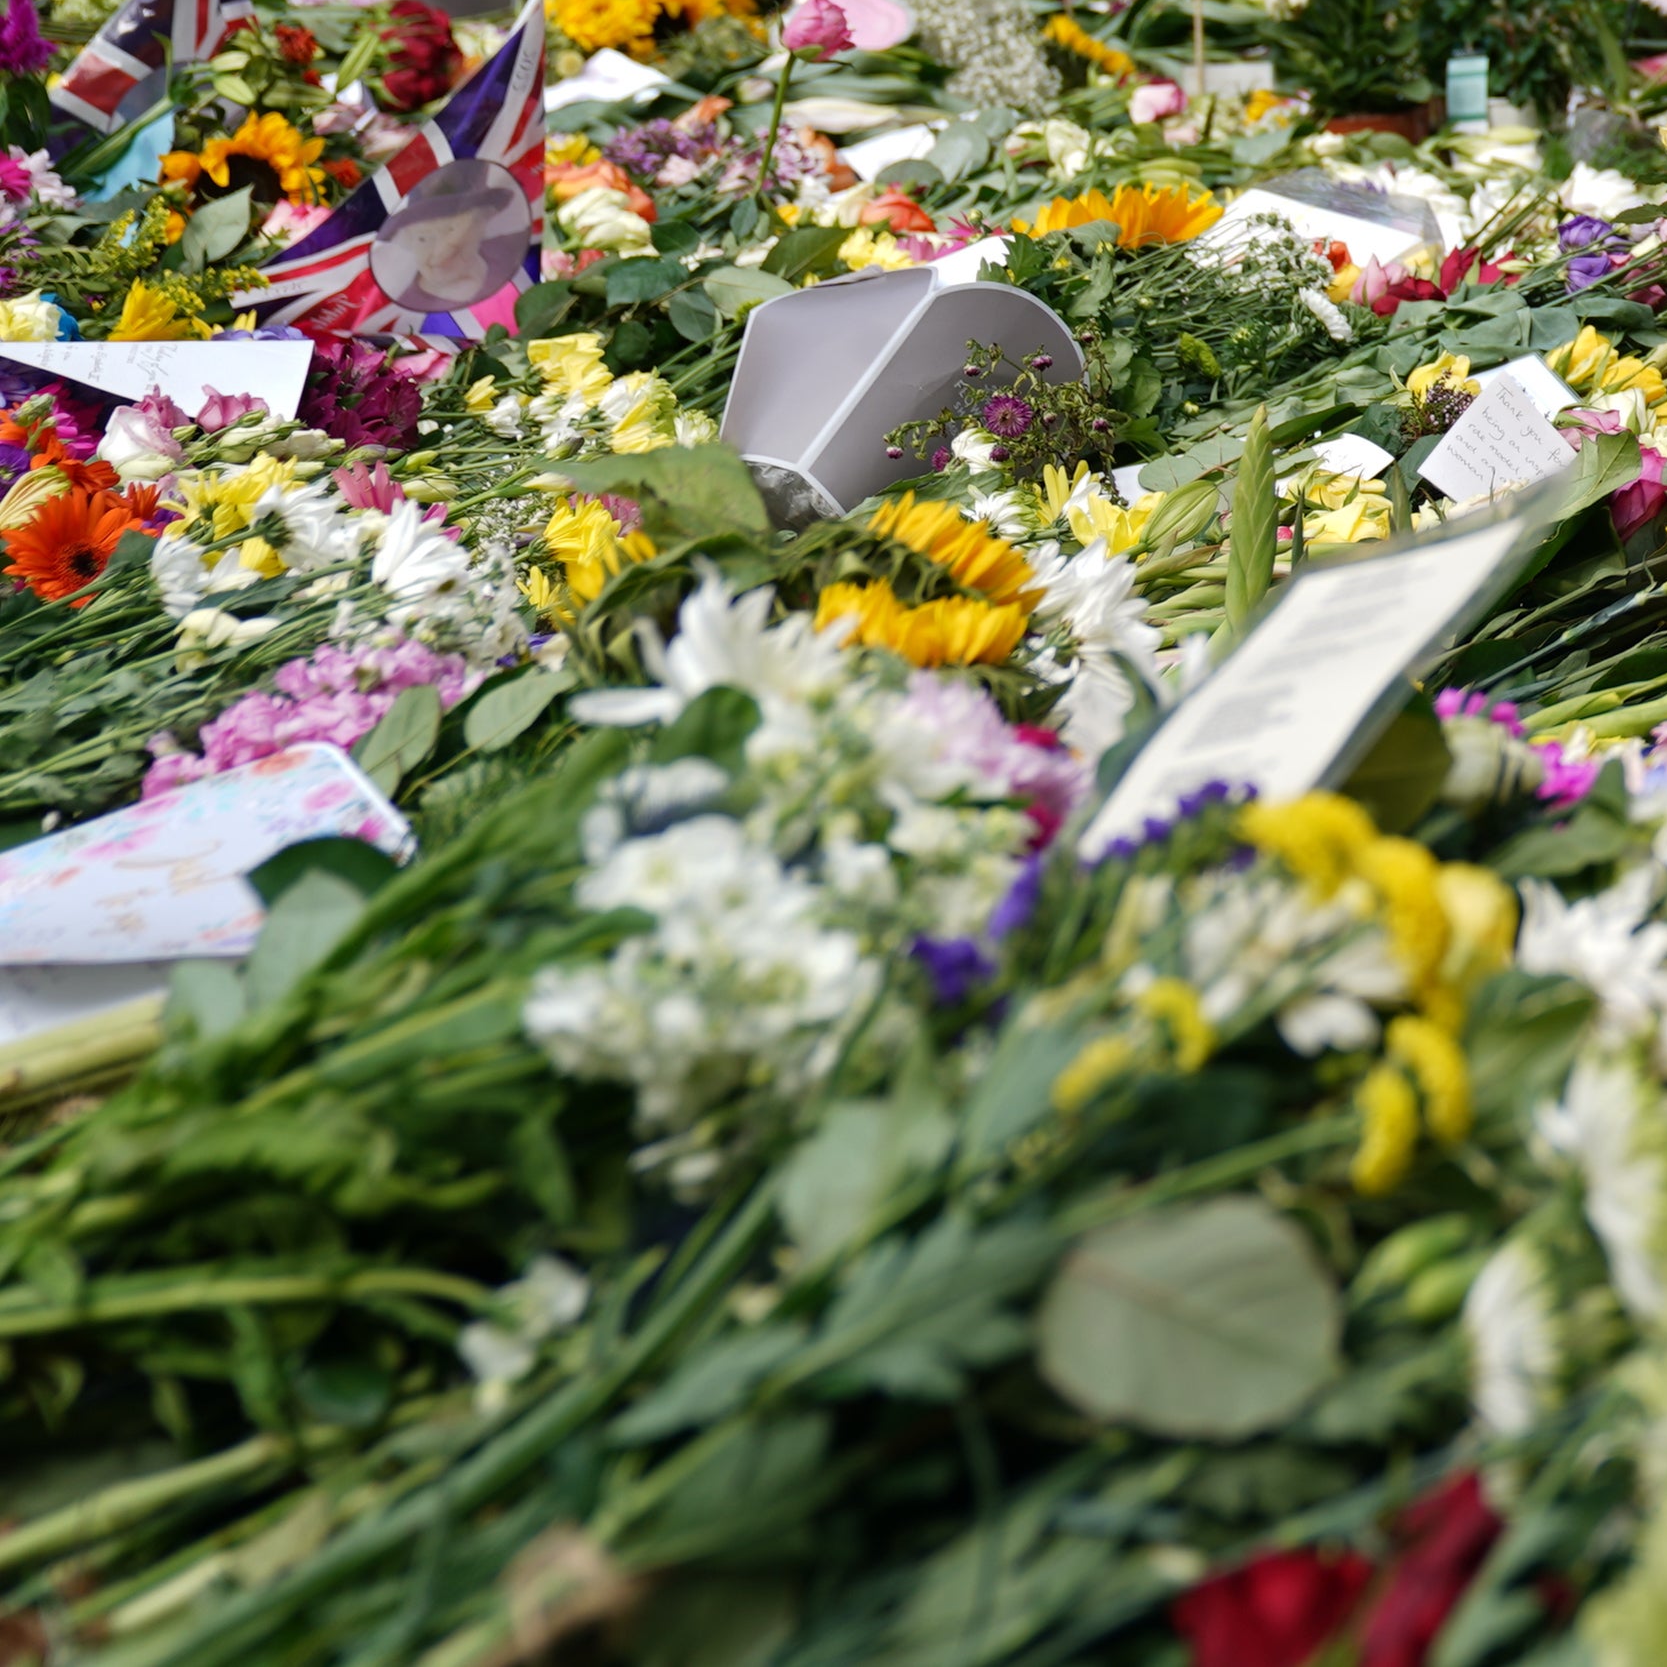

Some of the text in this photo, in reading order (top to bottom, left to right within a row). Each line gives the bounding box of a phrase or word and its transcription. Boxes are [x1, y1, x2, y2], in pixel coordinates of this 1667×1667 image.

[1467, 422, 1486, 443] role
[1482, 406, 1546, 478] being an insp
[1495, 382, 1523, 421] Thank
[1520, 425, 1543, 445] you
[1547, 447, 1567, 468] for
[1447, 443, 1485, 481] woman
[1455, 434, 1478, 455] and
